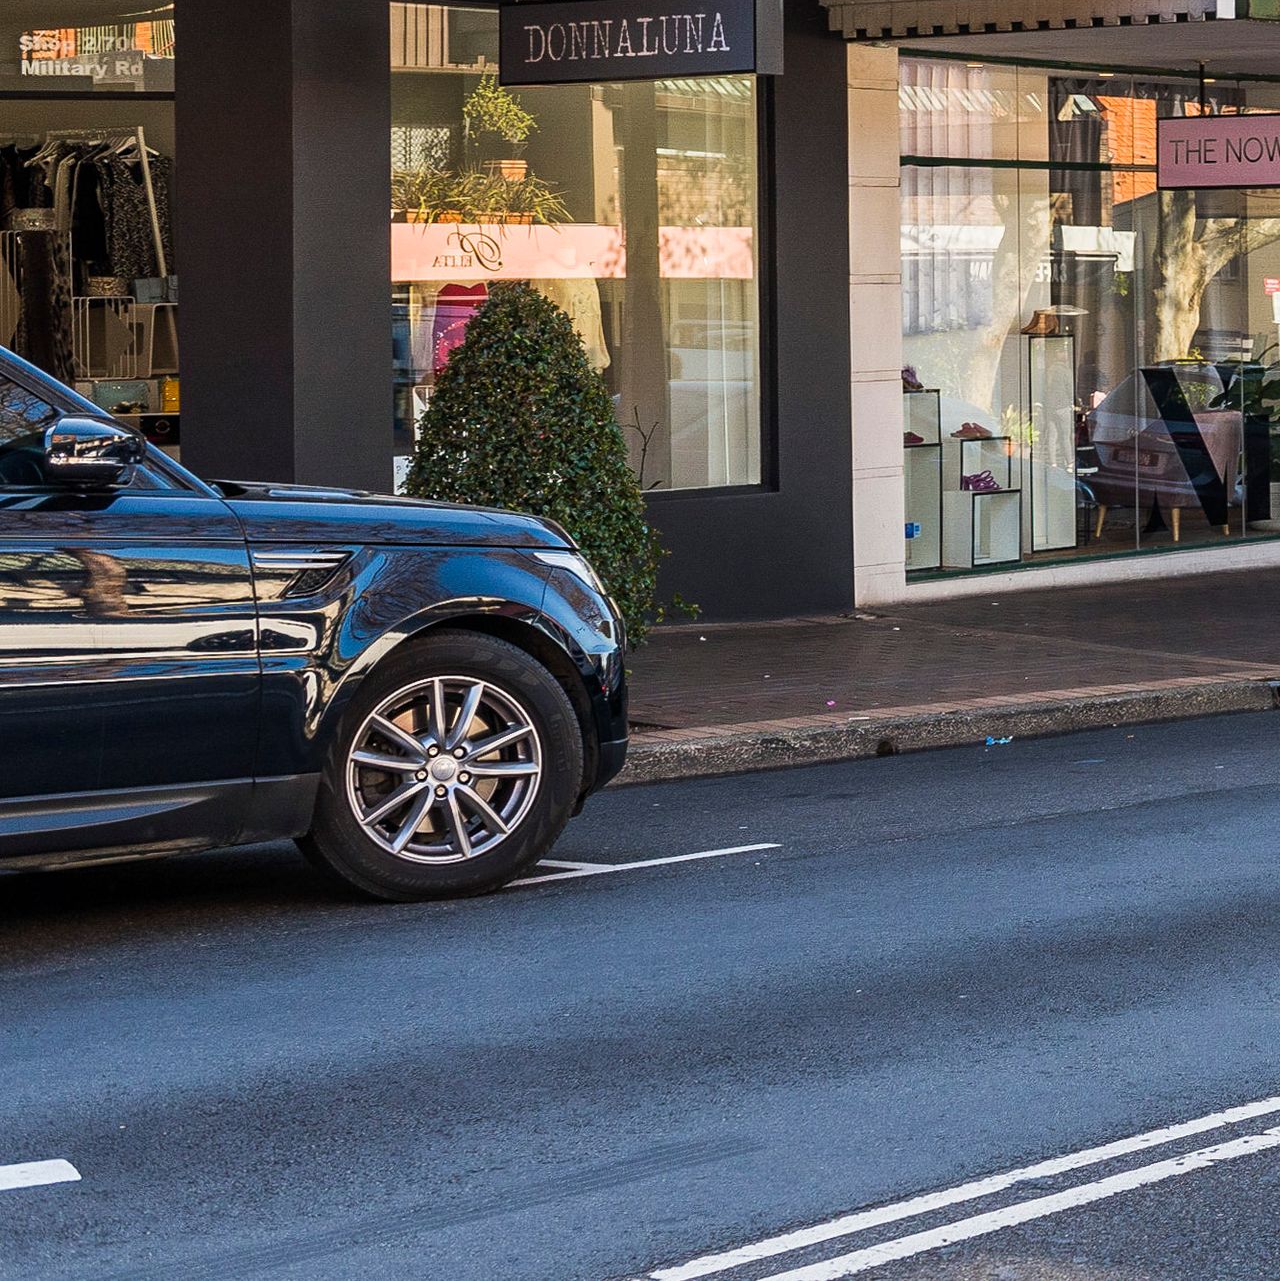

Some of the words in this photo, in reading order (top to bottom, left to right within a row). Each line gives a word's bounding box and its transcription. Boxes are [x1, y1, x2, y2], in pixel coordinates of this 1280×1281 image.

[524, 12, 731, 63] DONNALUNA
[22, 59, 108, 79] Military
[115, 60, 144, 76] Rd
[1169, 138, 1217, 165] THE
